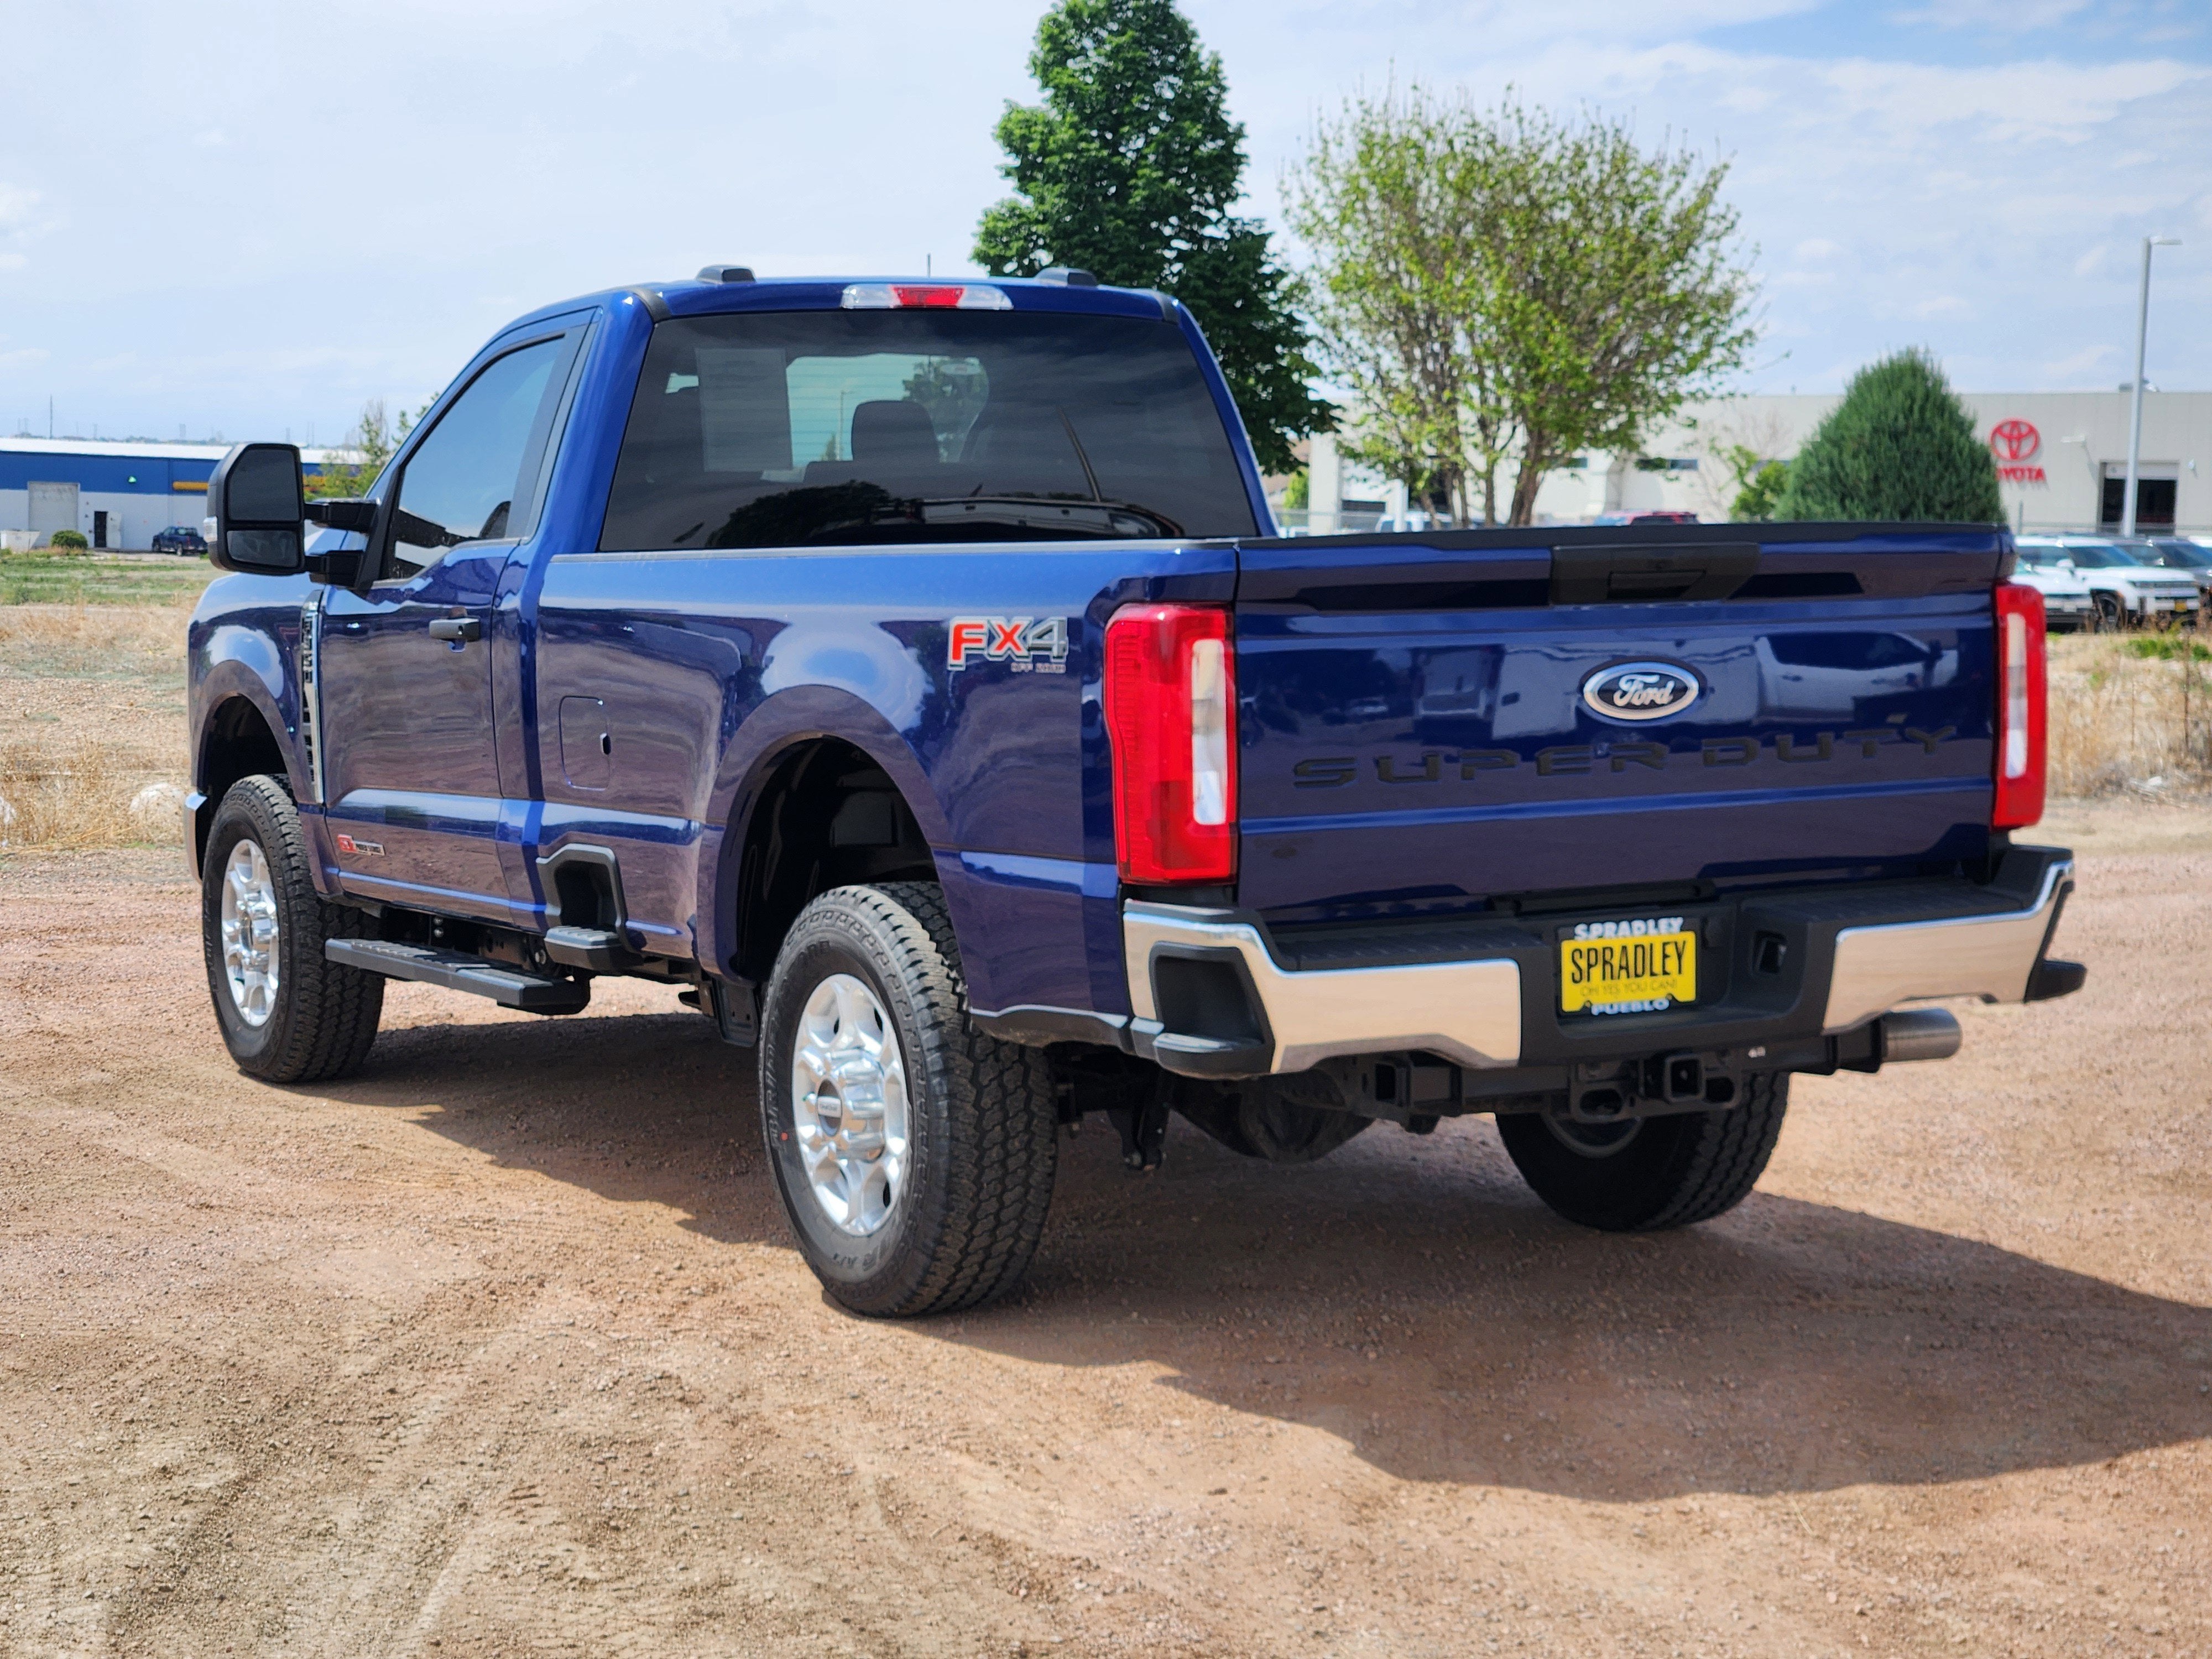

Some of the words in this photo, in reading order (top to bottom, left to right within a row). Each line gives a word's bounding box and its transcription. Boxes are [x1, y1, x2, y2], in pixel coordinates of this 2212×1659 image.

[947, 616, 1068, 670] FX4
[1613, 674, 1675, 706] Ford
[1293, 742, 1671, 787] SUPER
[1700, 726, 1957, 768] DUTY
[1572, 941, 1686, 984] SPRADLEY
